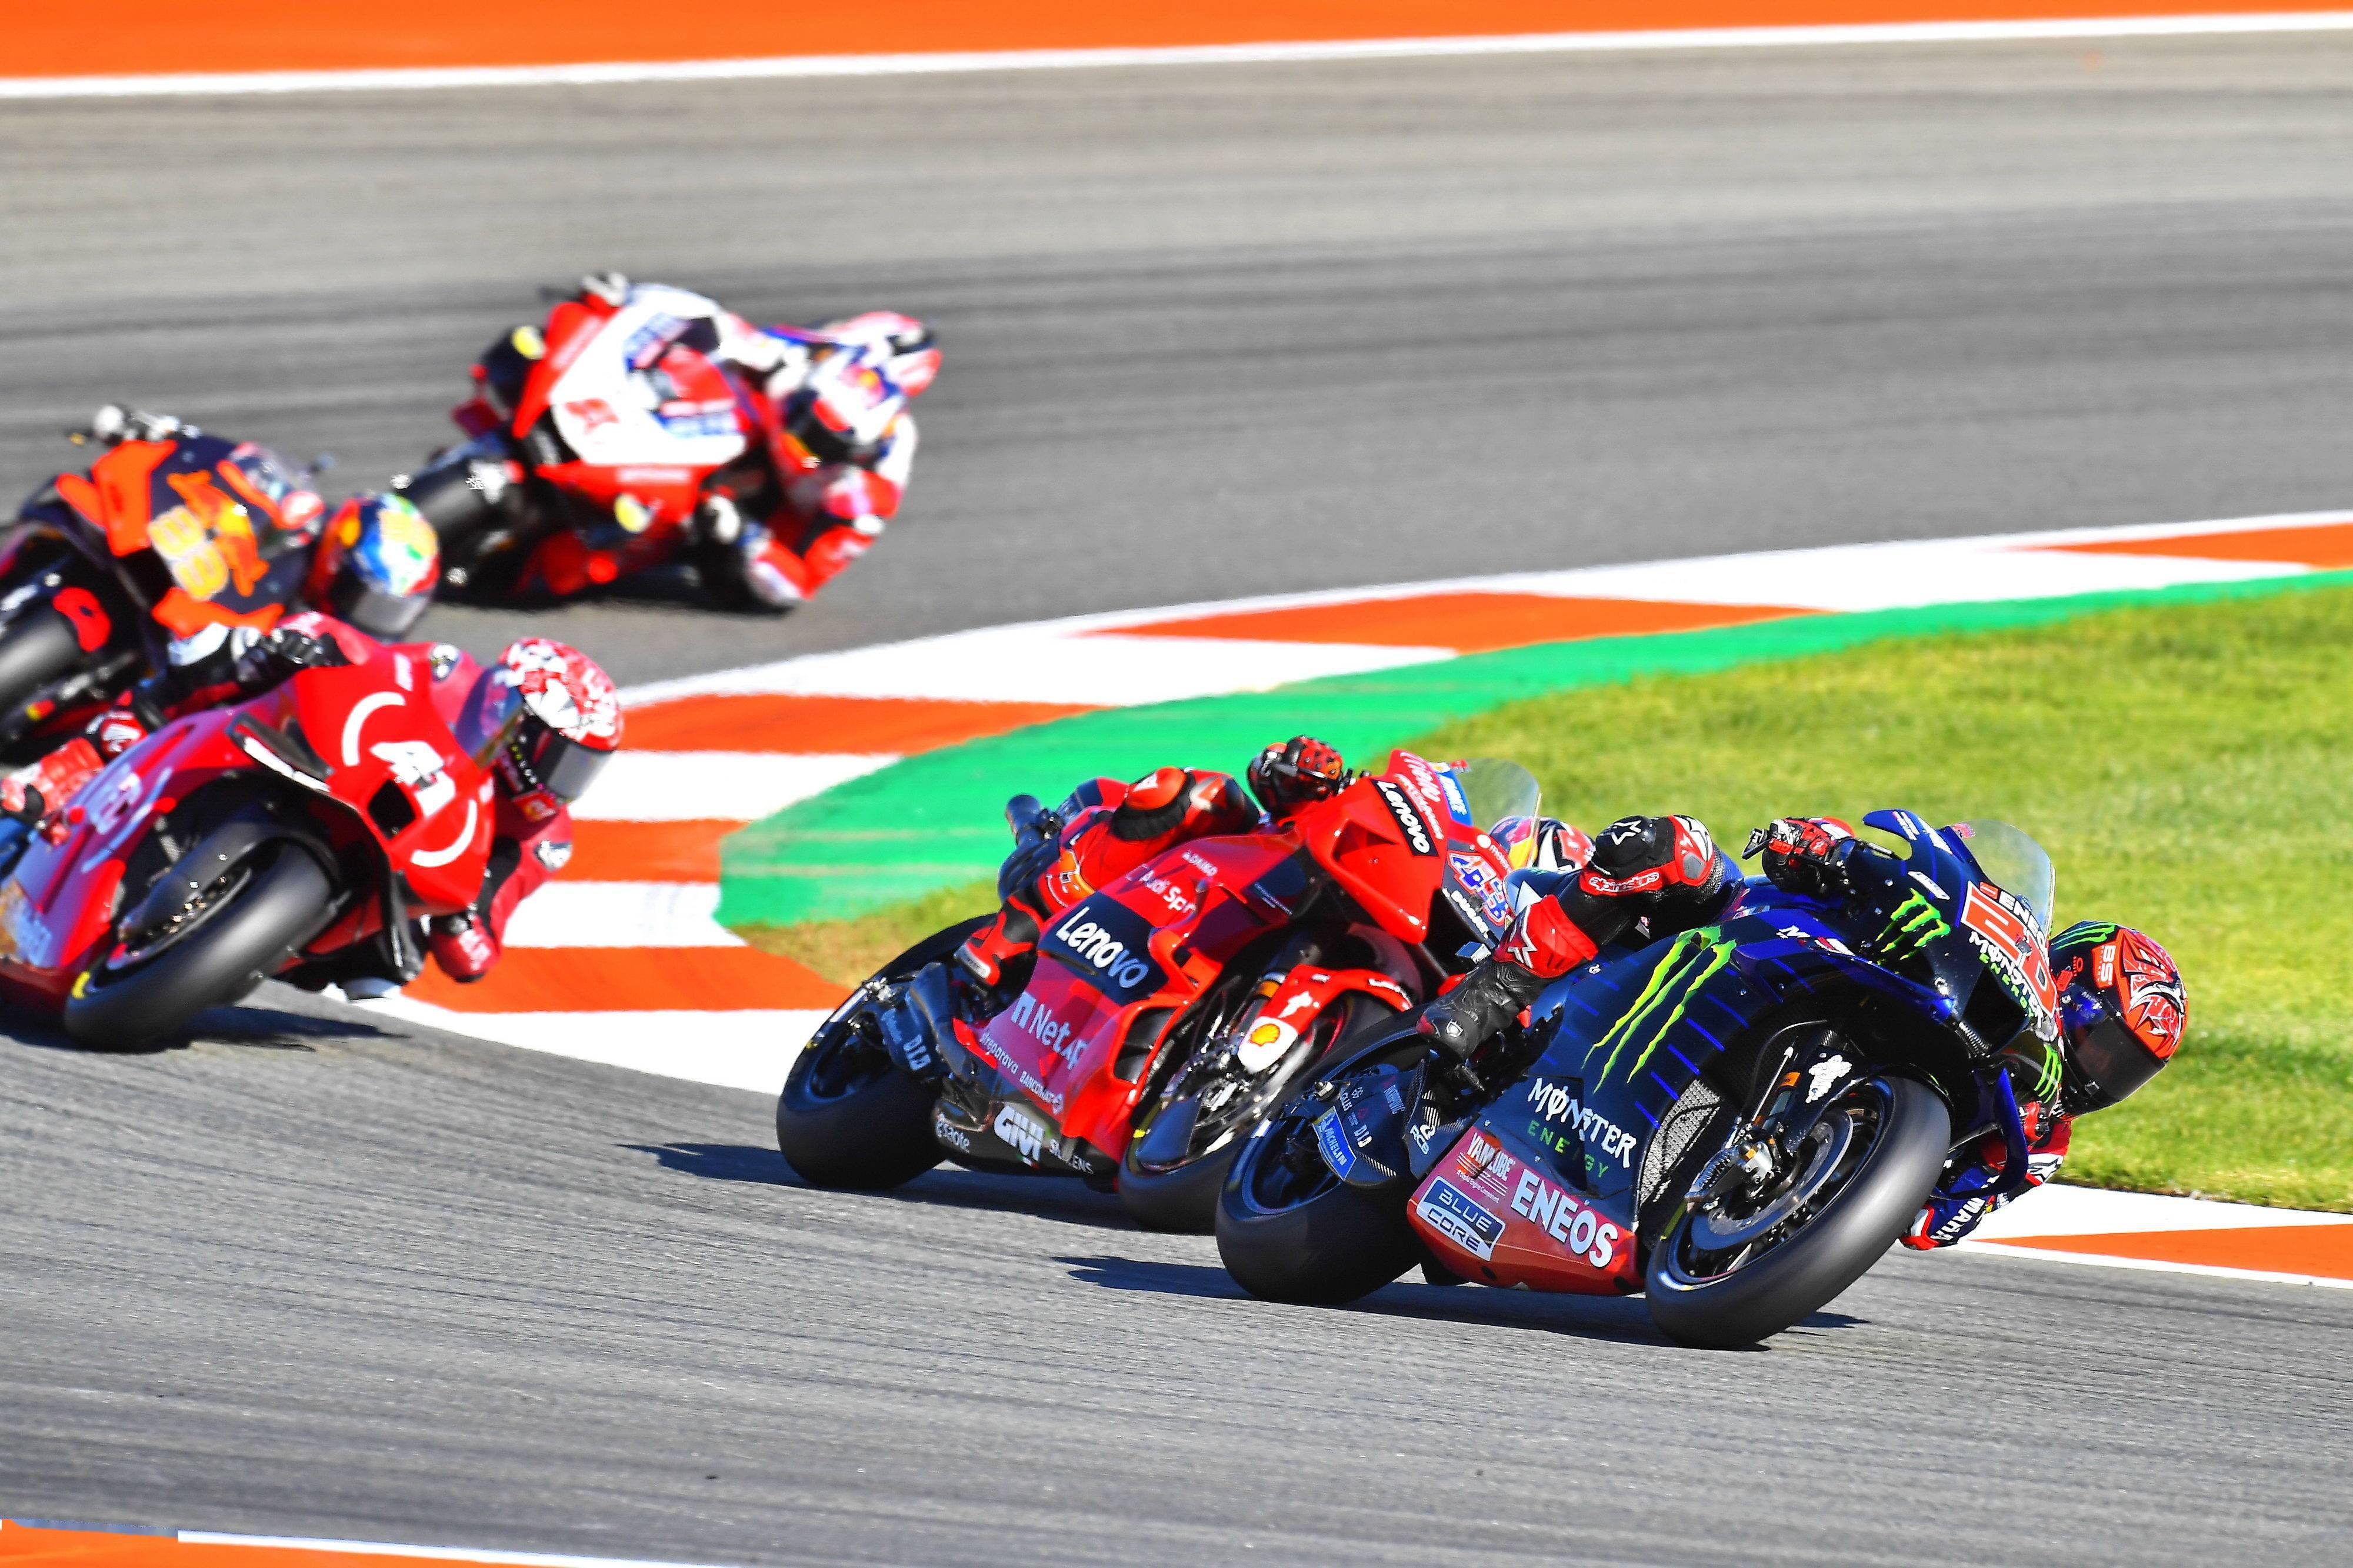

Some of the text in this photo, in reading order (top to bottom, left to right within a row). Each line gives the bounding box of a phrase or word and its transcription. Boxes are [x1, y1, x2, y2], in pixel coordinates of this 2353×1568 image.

[1377, 780, 1430, 853] Lenovo
[1055, 906, 1149, 989] Lenovo
[2101, 945, 2117, 983] BS
[994, 1105, 1045, 1163] GIVI
[1354, 1124, 1372, 1148] DID
[1409, 1125, 1429, 1155] RCB
[1528, 1077, 1637, 1169] MONSTER
[1528, 1119, 1609, 1178] ENEGY
[1427, 1207, 1481, 1252] CORE
[1438, 1188, 1492, 1233] BLUE
[1511, 1168, 1618, 1268] ENEOS
